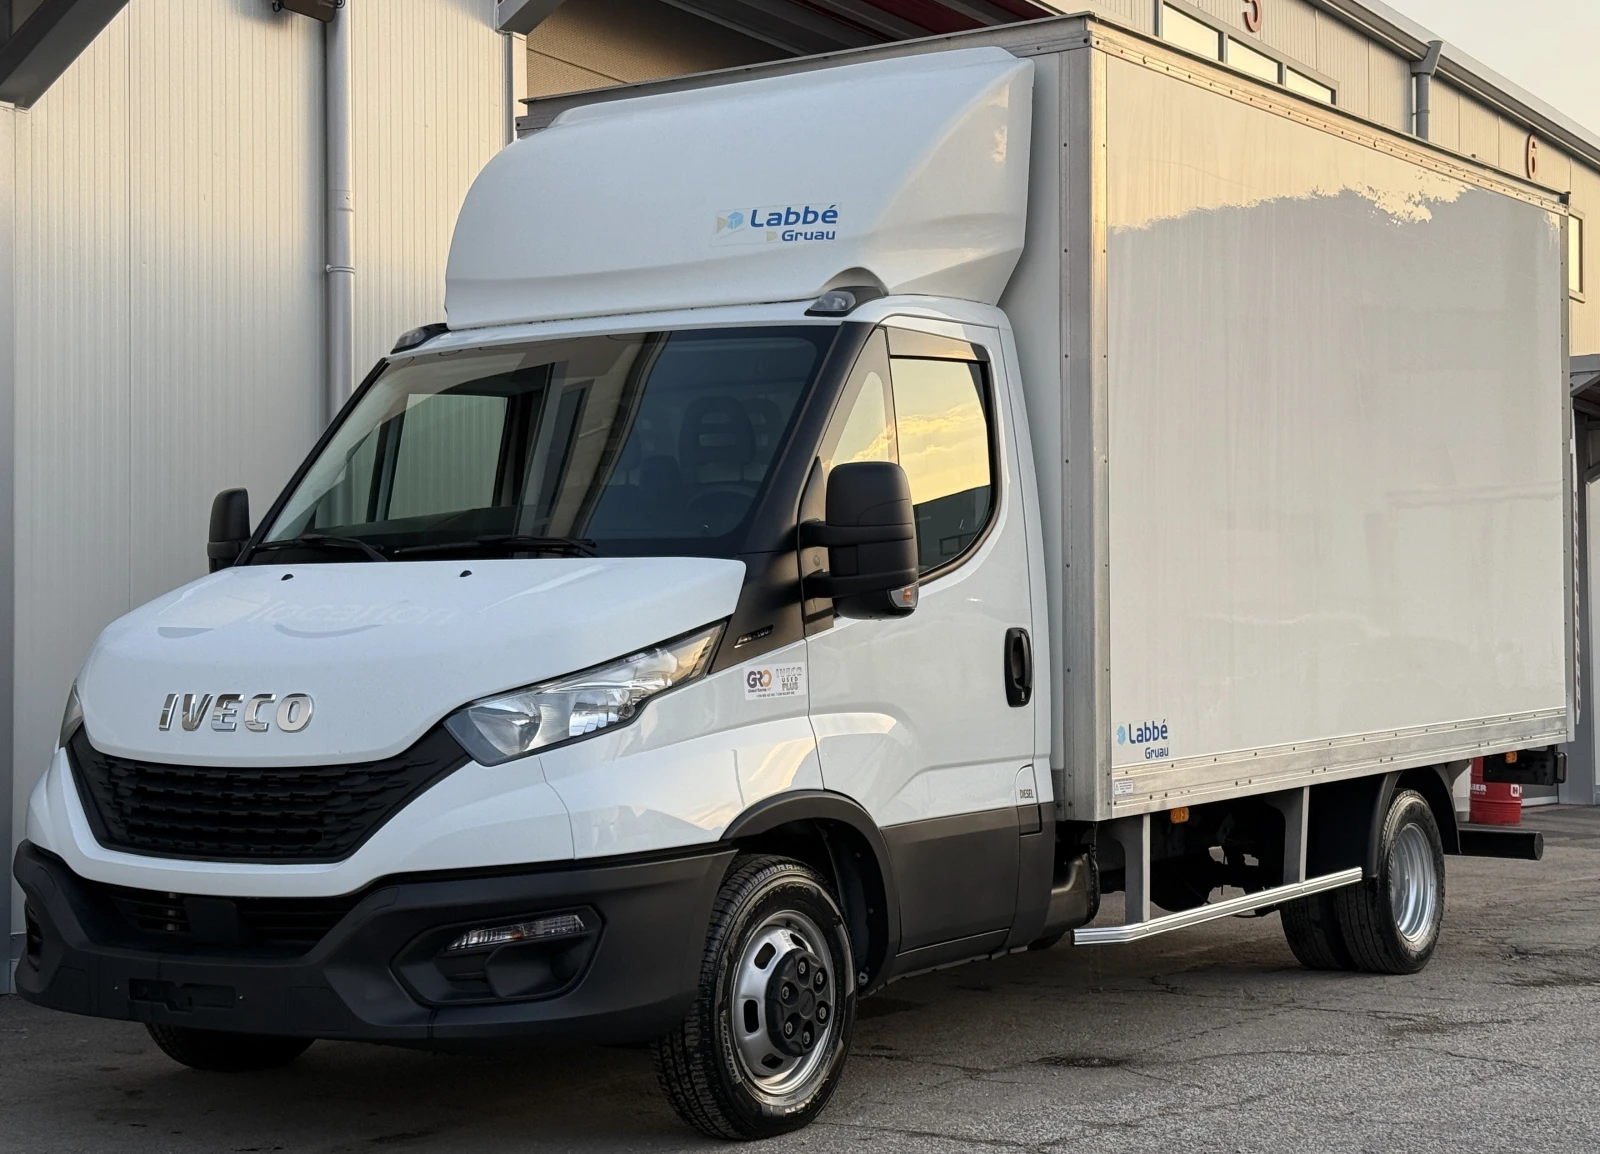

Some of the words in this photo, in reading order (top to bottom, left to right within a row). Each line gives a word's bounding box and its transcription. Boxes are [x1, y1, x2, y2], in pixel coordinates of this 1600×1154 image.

[1525, 133, 1538, 181] 6
[750, 204, 839, 228] Labbé
[781, 229, 836, 242] Gruau
[746, 669, 772, 689] GRO
[781, 682, 799, 691] PLUS
[158, 693, 315, 734] IVECO
[1128, 718, 1168, 744] Labbé
[1144, 746, 1169, 760] Gruau
